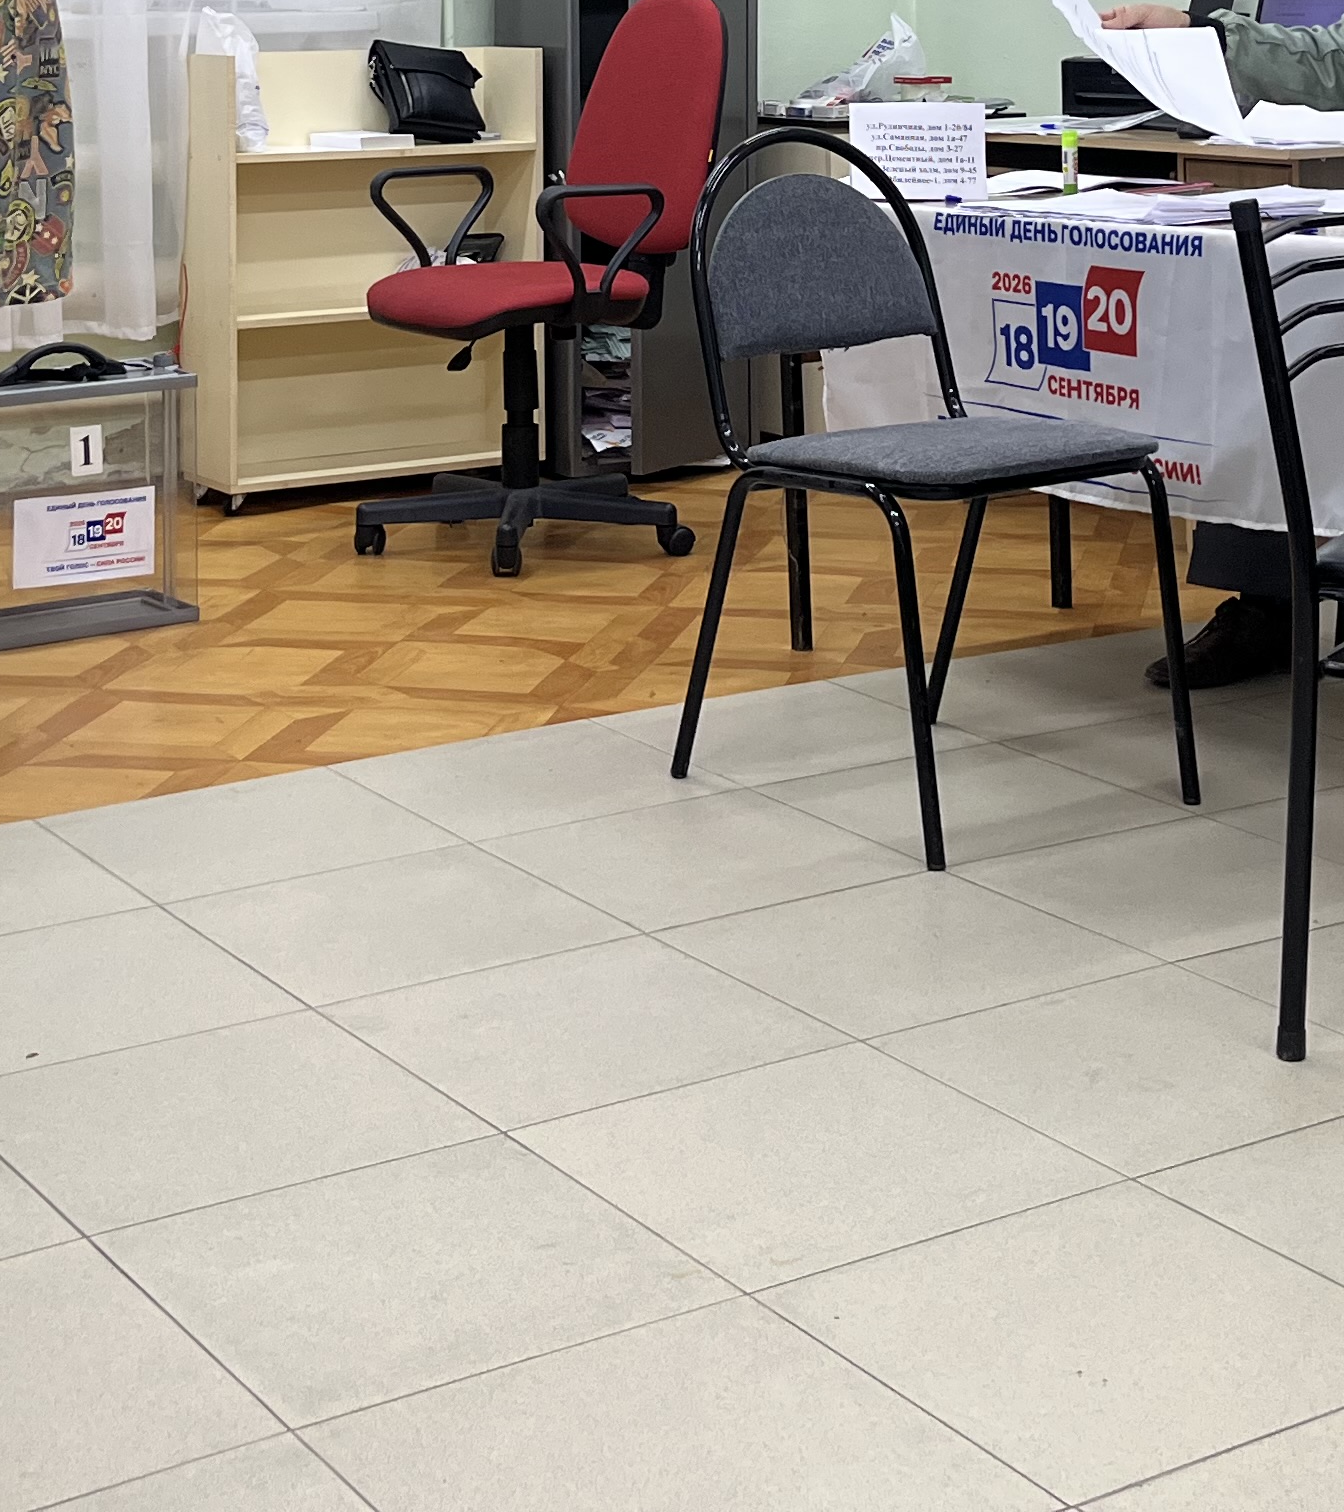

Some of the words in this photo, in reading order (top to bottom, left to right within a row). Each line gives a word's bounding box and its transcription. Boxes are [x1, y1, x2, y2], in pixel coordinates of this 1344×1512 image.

[934, 212, 1005, 238] ЕДИНЫЙ
[1010, 220, 1057, 244] ДЕНЬ
[1060, 224, 1202, 258] ГОЛОСОВАНИЯ
[992, 272, 1032, 294] 2026
[1000, 324, 1034, 370] 18
[1041, 304, 1079, 351] 19
[1087, 286, 1132, 336] 20
[1048, 374, 1140, 410] СЕНТЯБРЯ
[79, 434, 93, 466] 1
[72, 534, 85, 546] 18
[88, 525, 102, 538] 19
[106, 517, 122, 530] 20
